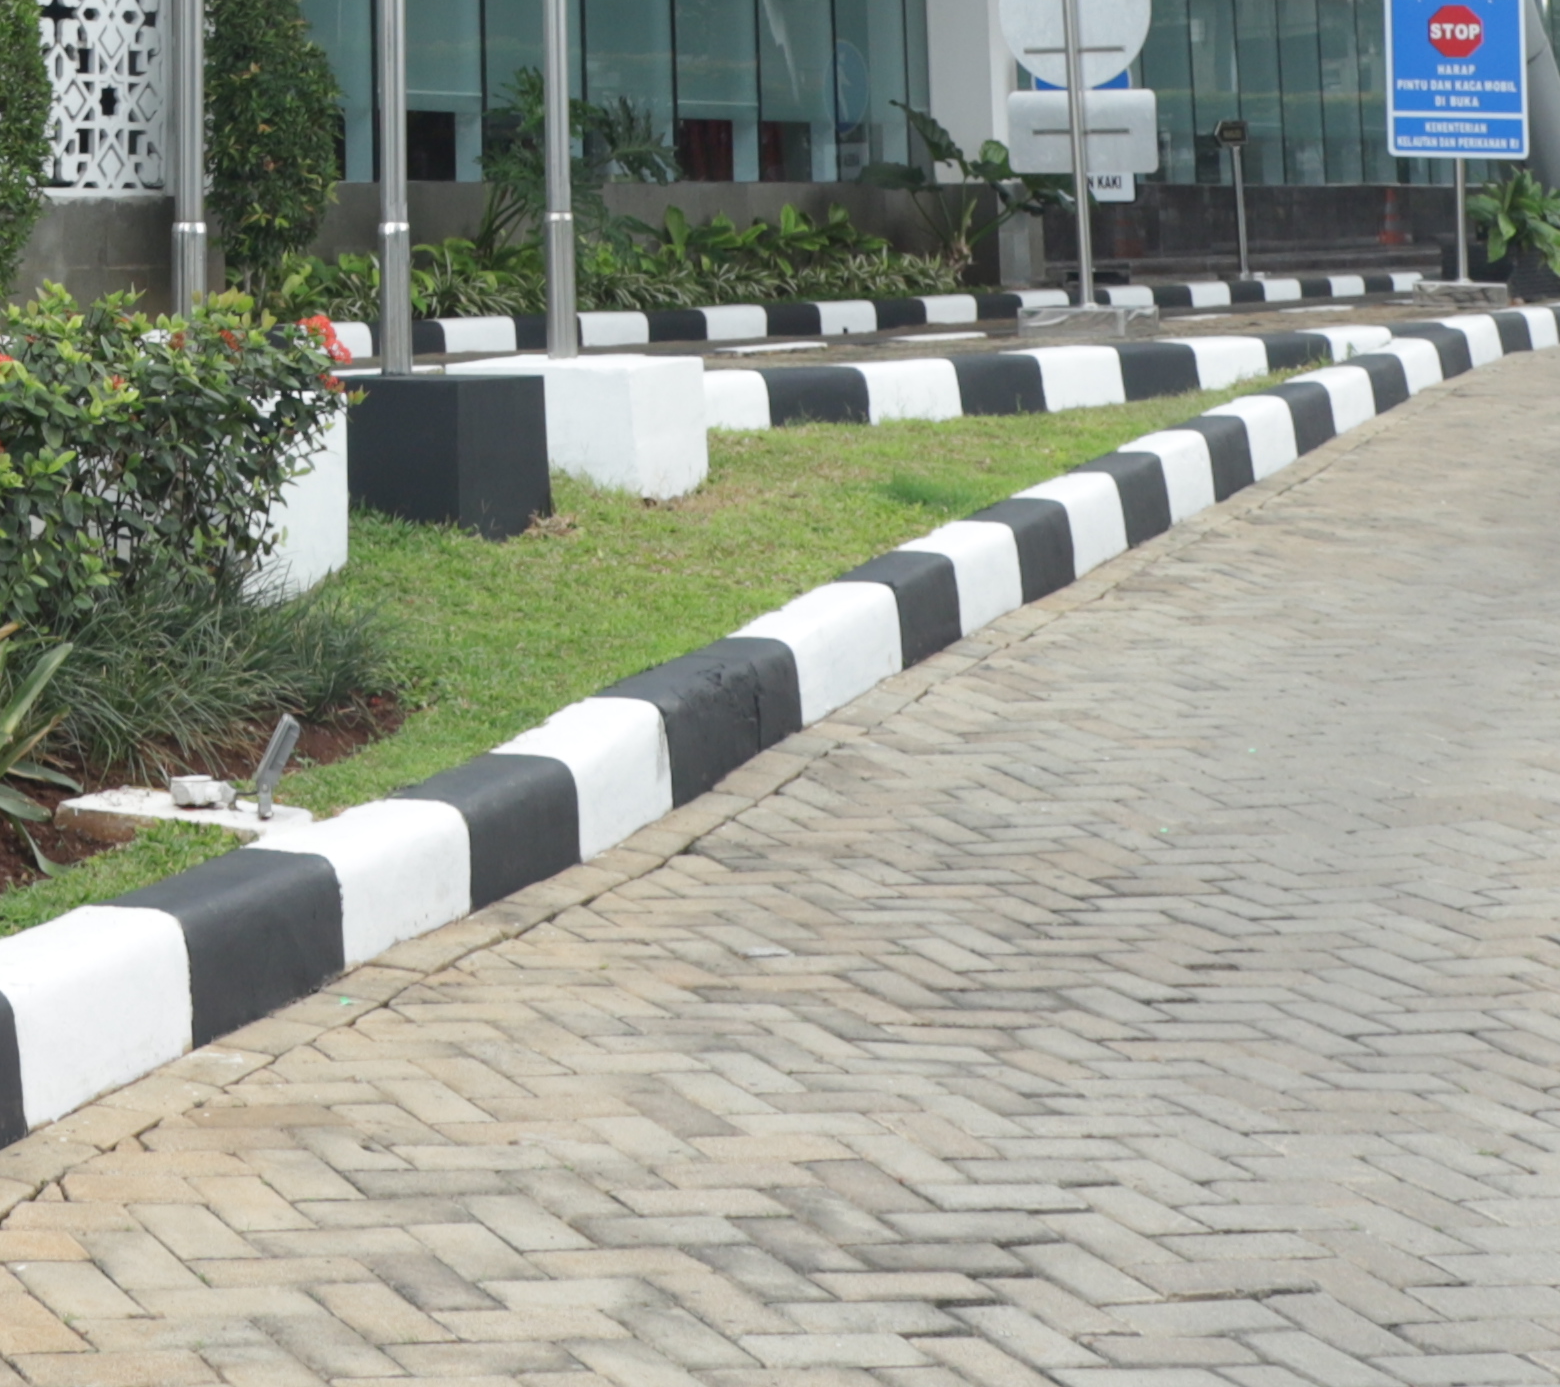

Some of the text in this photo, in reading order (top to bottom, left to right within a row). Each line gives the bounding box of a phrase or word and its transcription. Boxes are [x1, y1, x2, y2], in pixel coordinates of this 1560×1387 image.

[1430, 23, 1481, 40] STOP
[1437, 64, 1476, 75] HARAP
[1397, 79, 1517, 93] PINTU DAN KACA MOBIL
[1435, 95, 1480, 107] DI BUKA
[1097, 176, 1122, 189] KAKI
